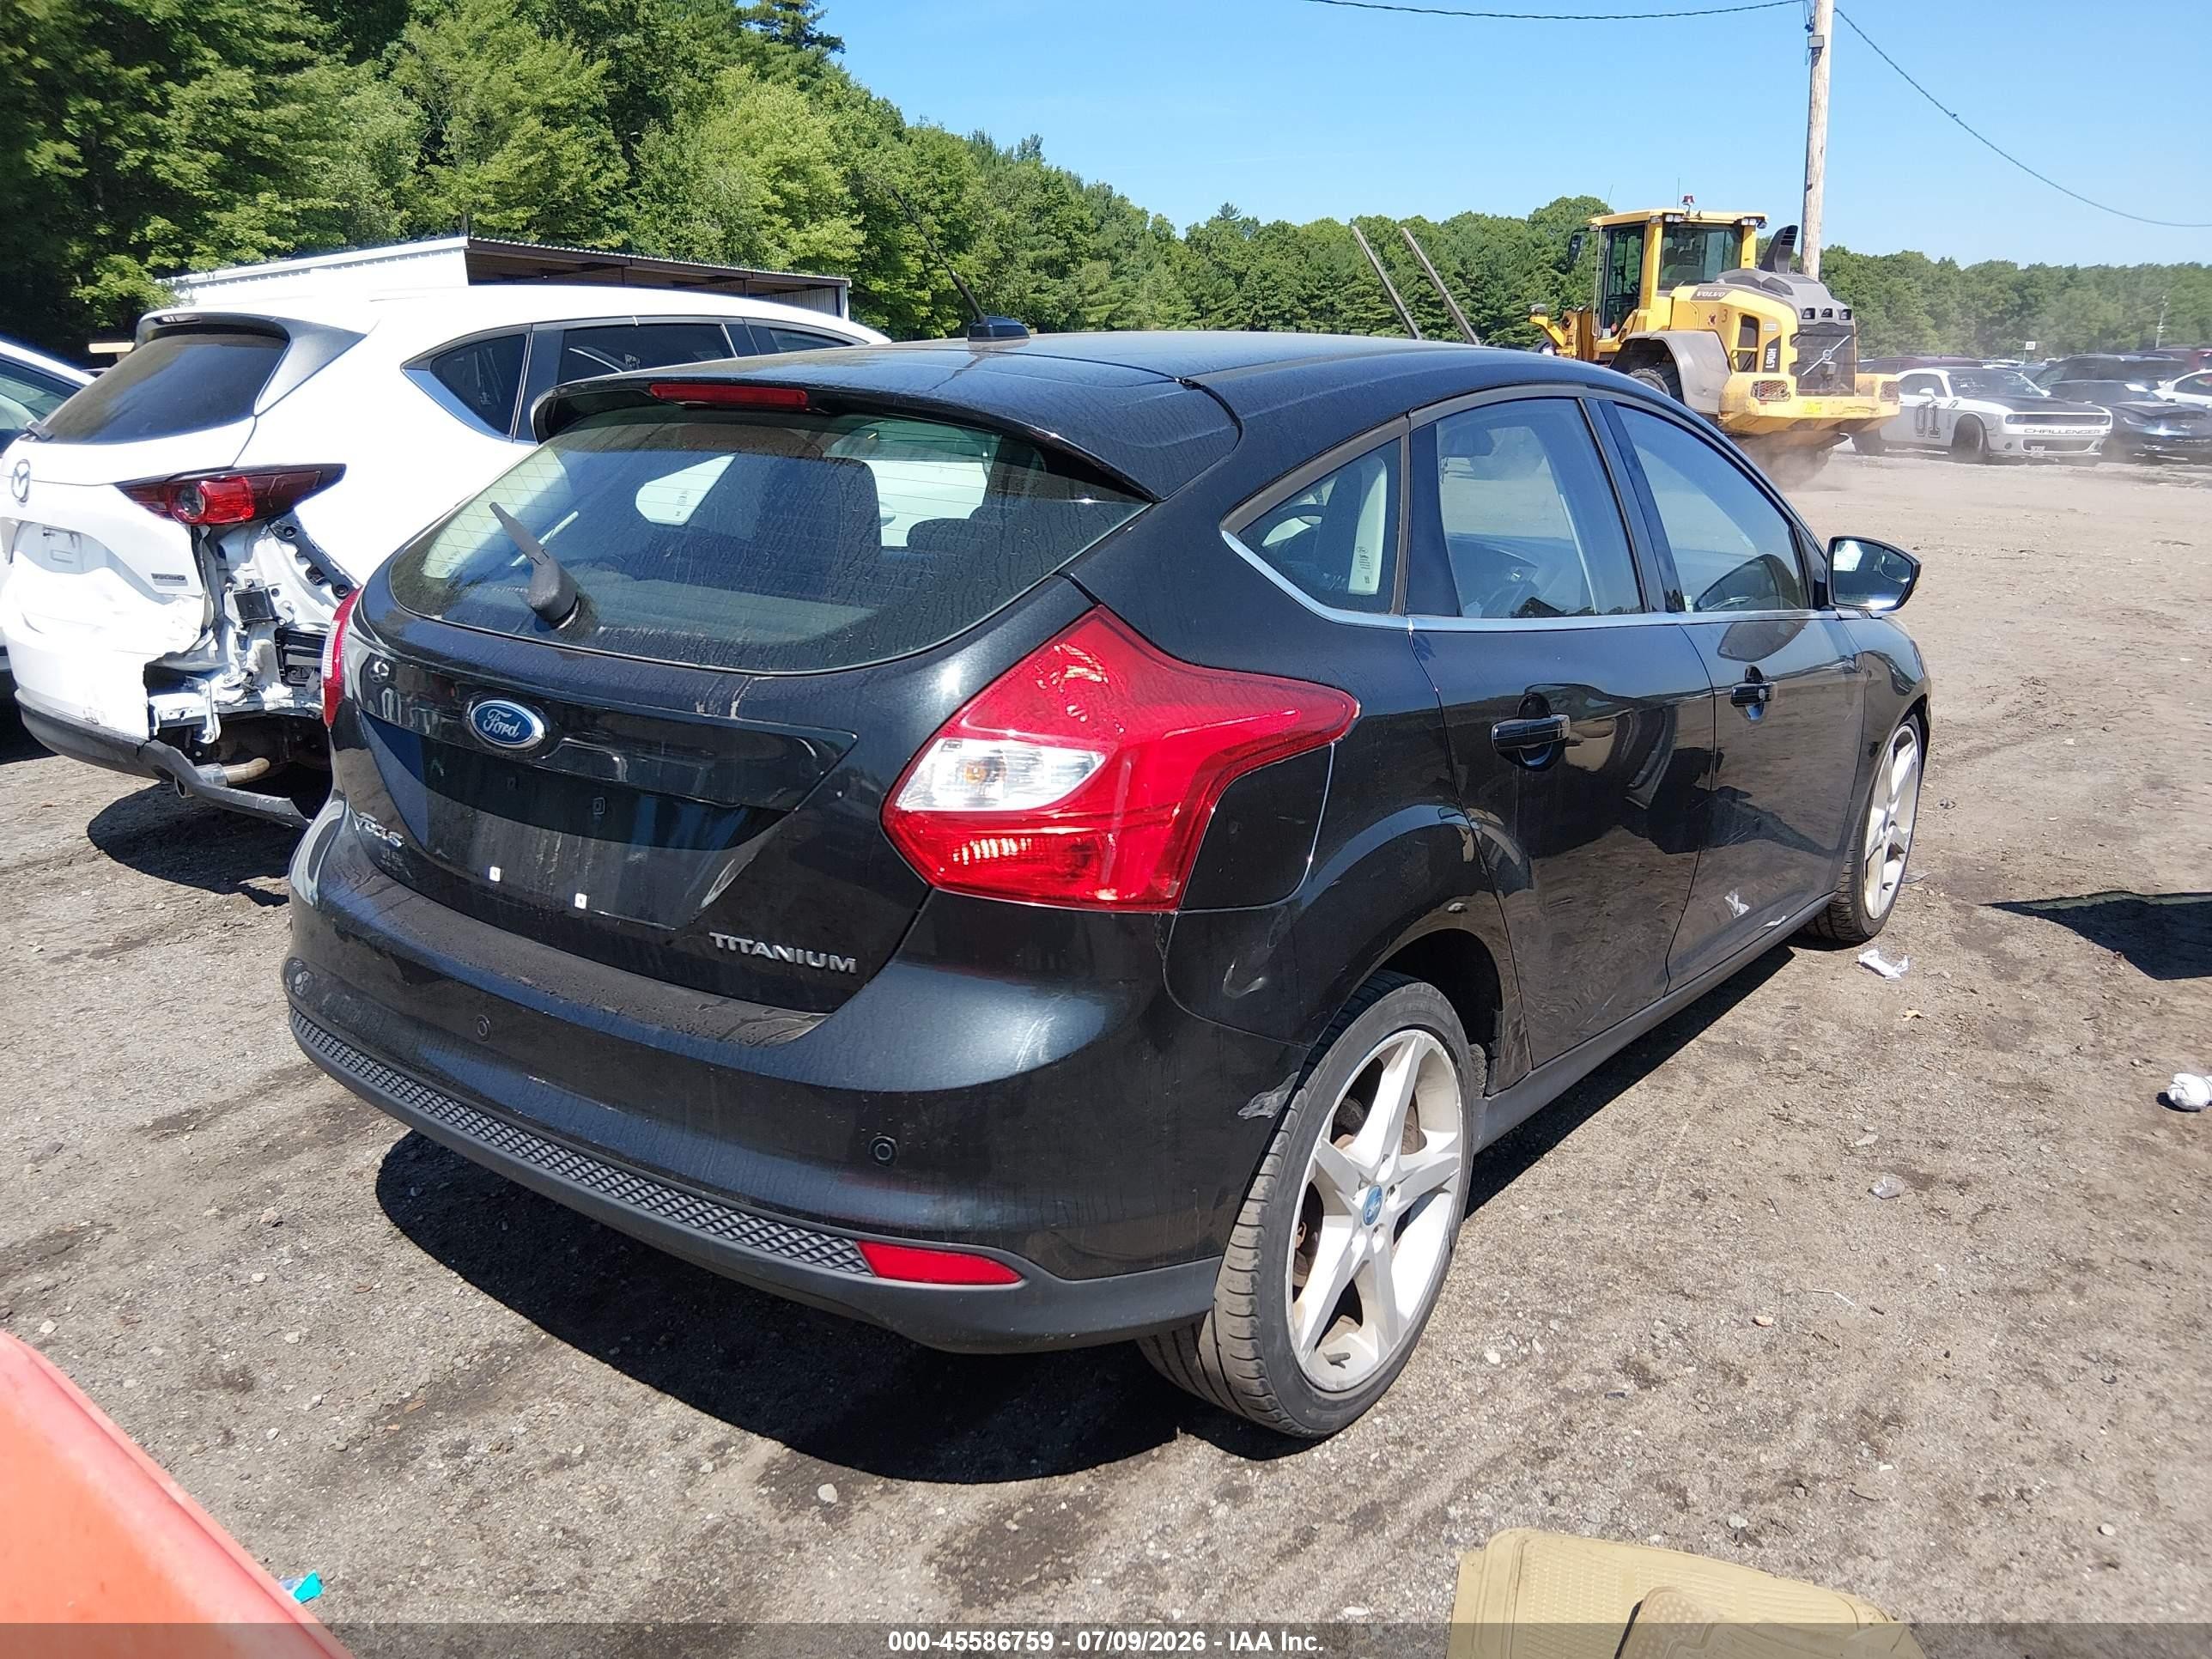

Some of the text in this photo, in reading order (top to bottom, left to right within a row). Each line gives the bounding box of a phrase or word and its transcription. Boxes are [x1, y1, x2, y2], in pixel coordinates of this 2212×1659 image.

[1721, 308, 1729, 323] 3
[1765, 348, 1778, 369] L90H
[1915, 402, 1942, 439] 01
[483, 708, 522, 738] Ford
[708, 932, 858, 975] TITANIUM
